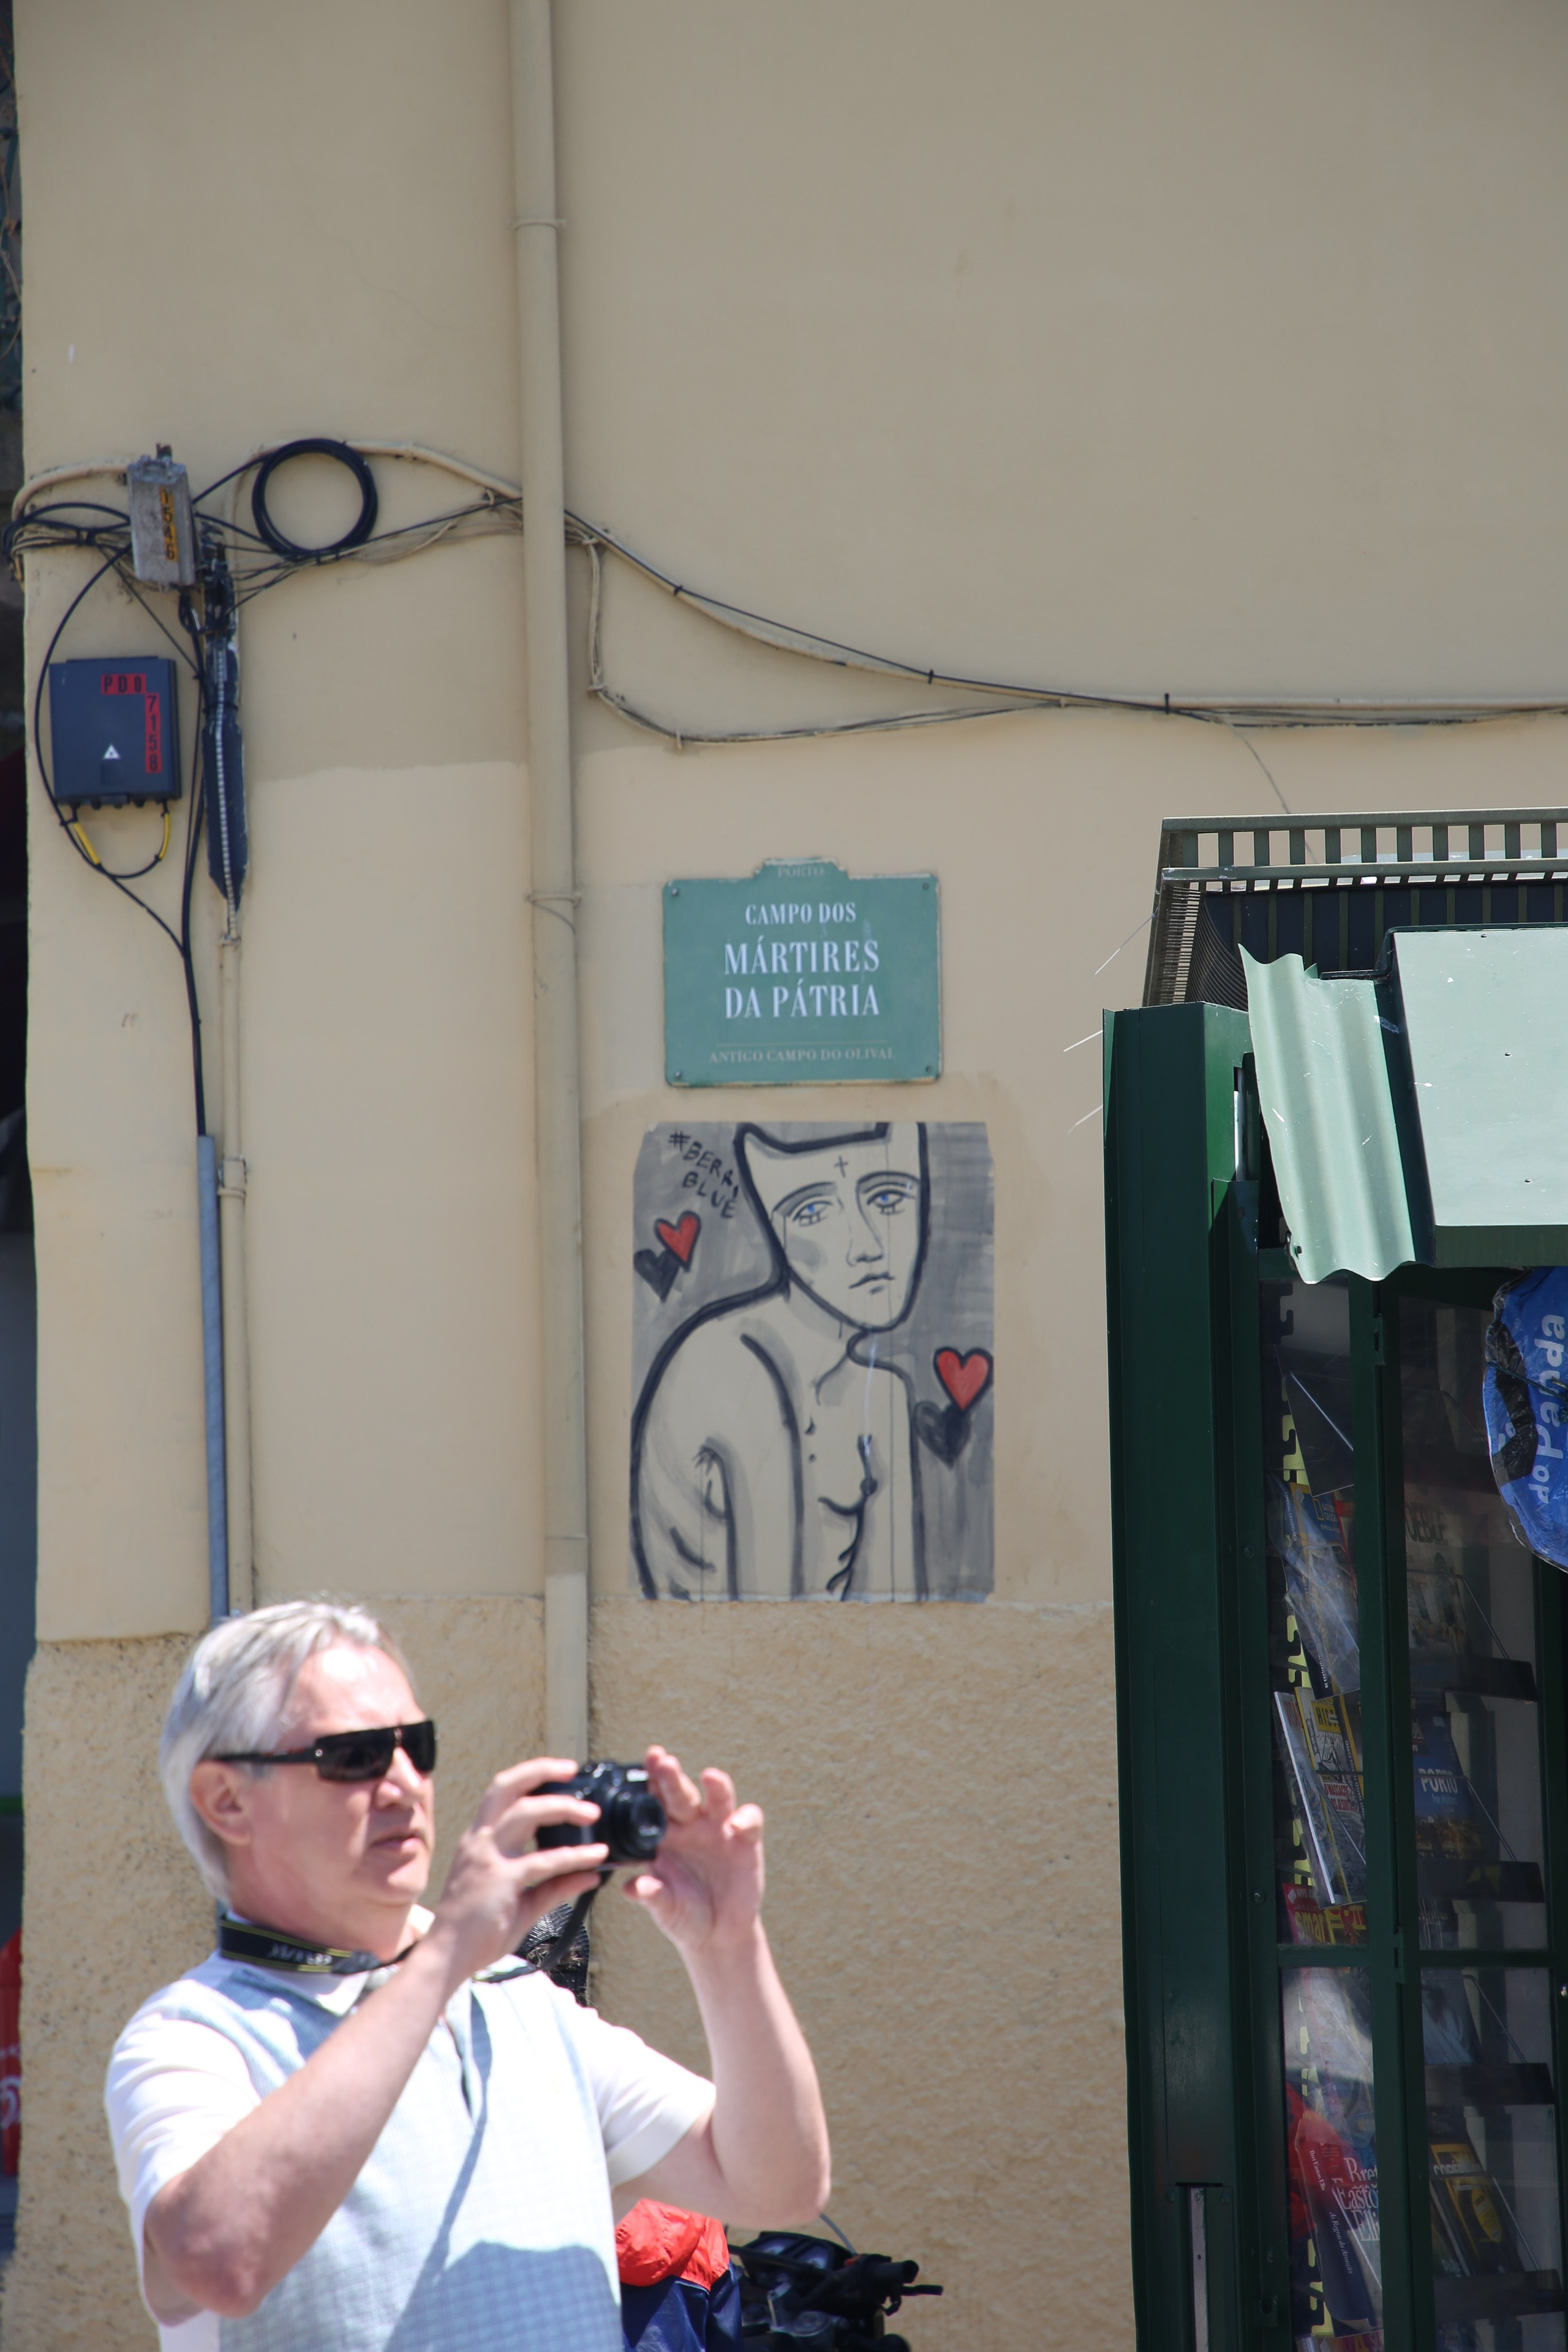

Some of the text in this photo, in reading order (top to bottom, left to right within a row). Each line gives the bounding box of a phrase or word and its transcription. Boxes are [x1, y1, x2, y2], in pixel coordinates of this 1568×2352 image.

[777, 865, 824, 878] PORTO
[745, 902, 857, 925] CAMPO DOS
[725, 935, 880, 975] MÁRTIRES
[725, 978, 880, 1019] DA PÁTRIA
[709, 1047, 897, 1063] ANTIGO CAMPO DO OLIVAL
[682, 1171, 736, 1218] BLUE
[1528, 1314, 1566, 1504] do Panda
